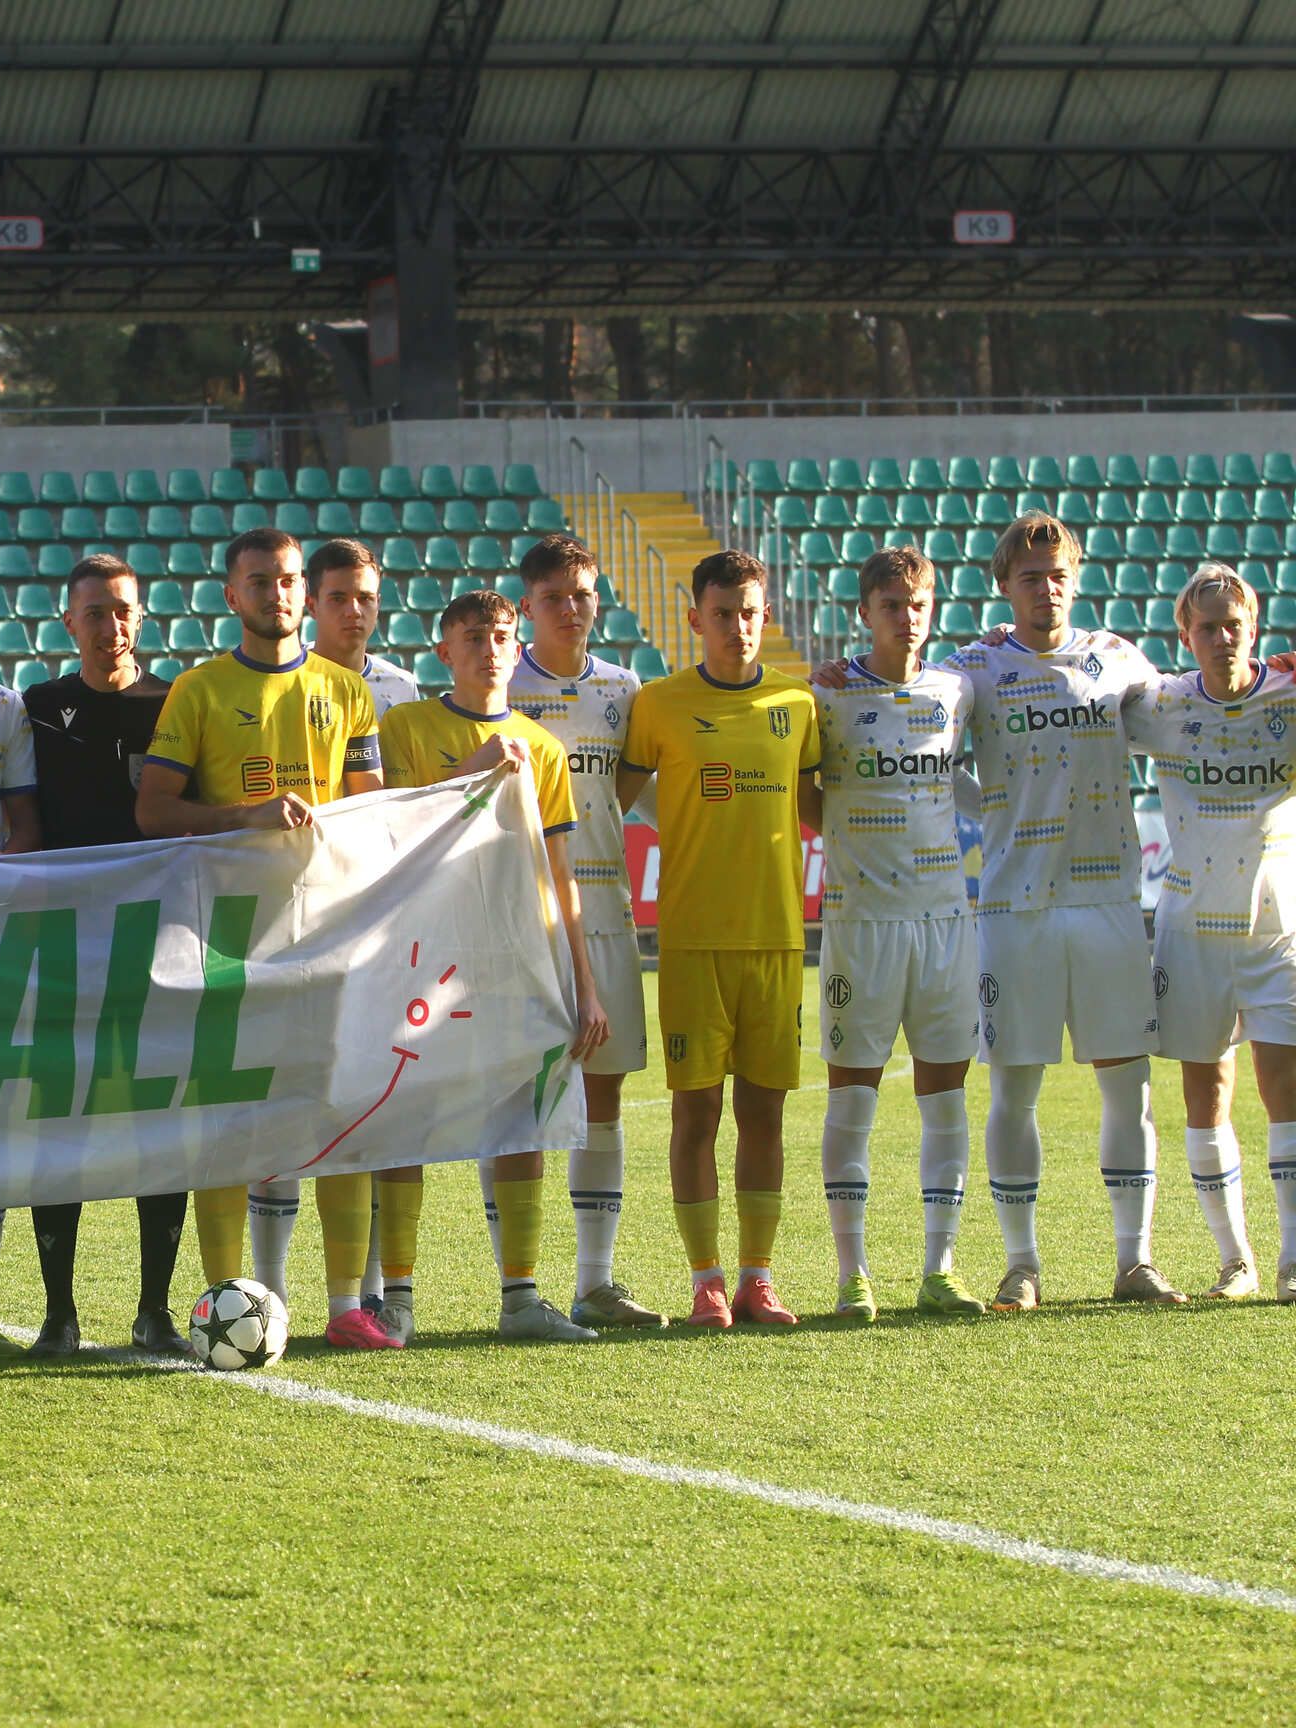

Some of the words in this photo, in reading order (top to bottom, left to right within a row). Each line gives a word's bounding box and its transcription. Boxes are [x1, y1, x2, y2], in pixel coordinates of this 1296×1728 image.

[968, 217, 1000, 237] K9
[345, 749, 373, 759] ESPECT
[275, 762, 309, 774] Banka
[567, 749, 617, 776] ank
[734, 768, 766, 779] Banka
[277, 775, 327, 788] Ekonoke
[735, 783, 788, 793] Ekonomike
[827, 975, 850, 1008] MG
